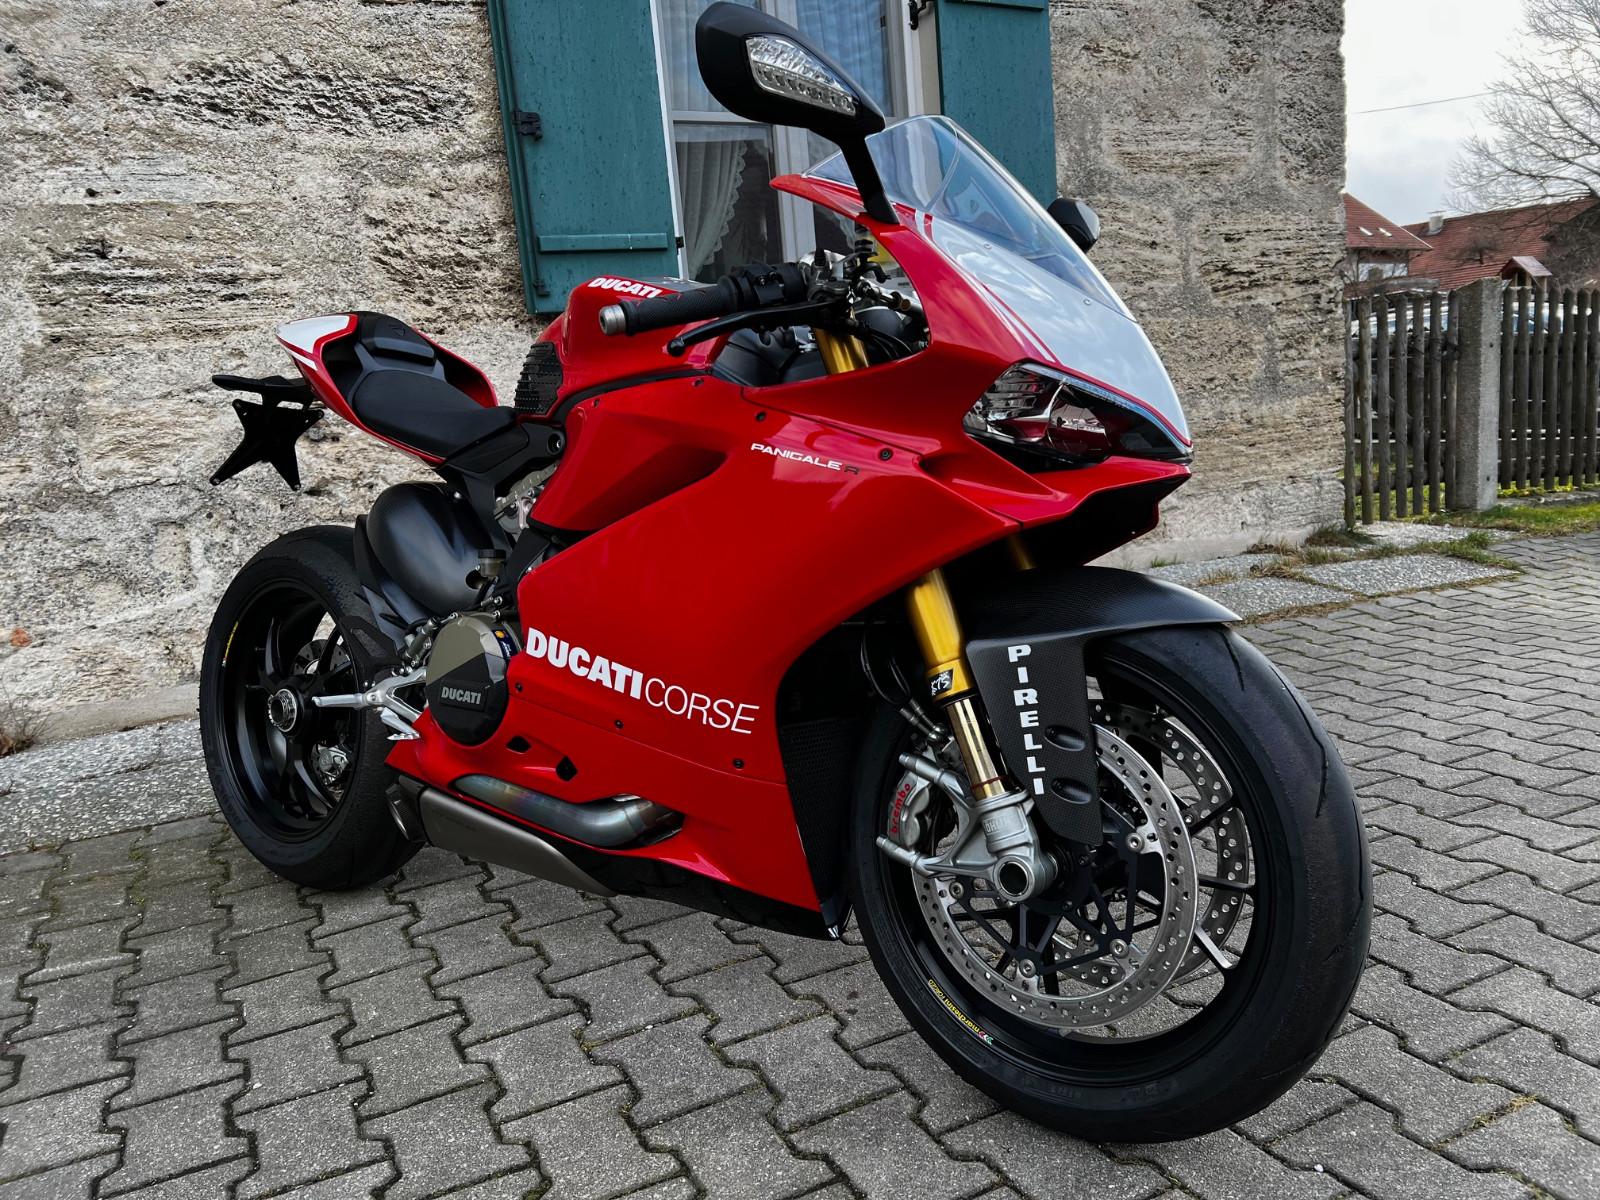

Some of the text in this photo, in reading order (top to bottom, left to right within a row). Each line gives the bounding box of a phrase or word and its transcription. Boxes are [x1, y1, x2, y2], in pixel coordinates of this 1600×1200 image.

[587, 277, 663, 299] DUCATI
[750, 443, 842, 471] PANIGALE
[441, 686, 481, 704] DUCATI
[526, 627, 760, 734] DUCATI CORSE
[1008, 644, 1045, 795] PIRELLI
[891, 783, 911, 833] brembo
